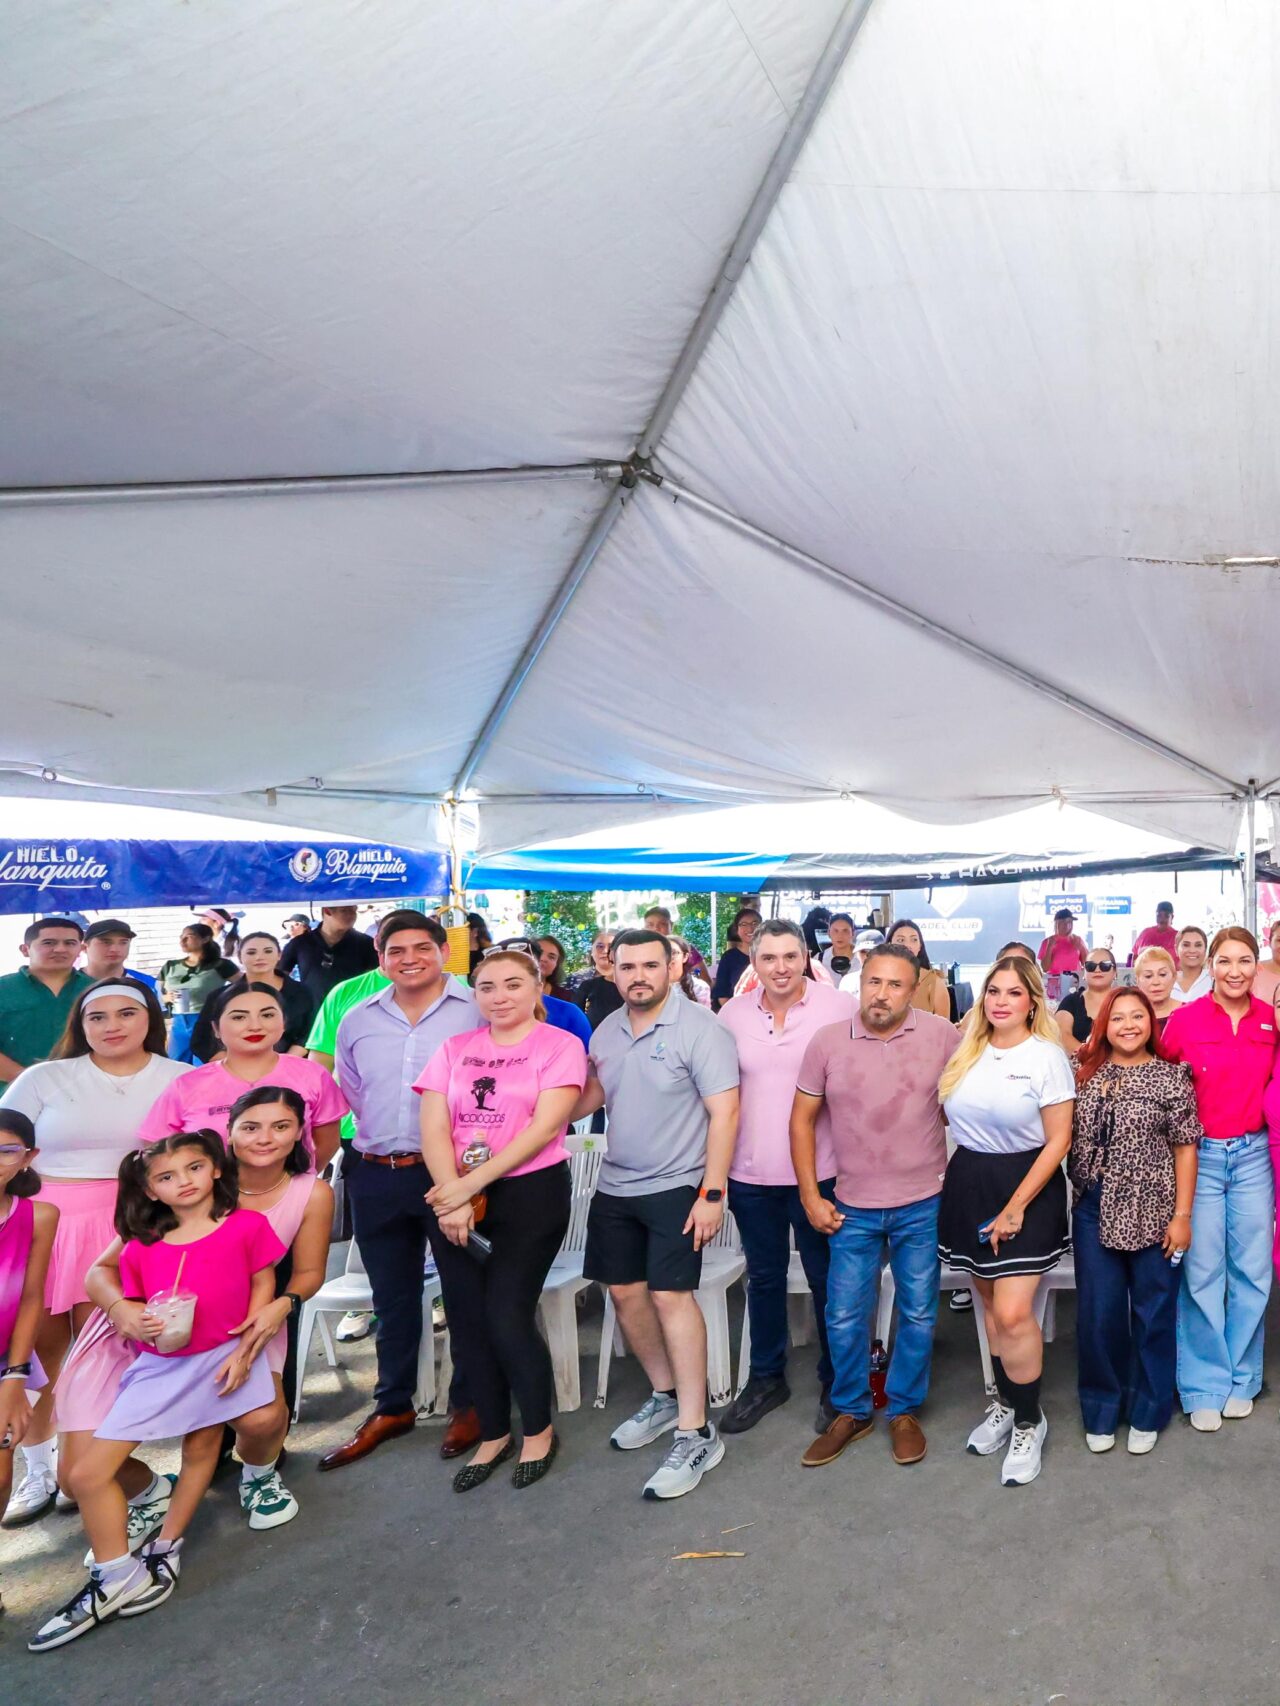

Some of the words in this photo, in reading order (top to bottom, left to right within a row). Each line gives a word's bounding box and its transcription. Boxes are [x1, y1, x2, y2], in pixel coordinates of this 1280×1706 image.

[17, 845, 78, 863] HIELO
[358, 849, 392, 862] HIELO
[325, 848, 407, 883] Blanquita
[689, 1448, 708, 1471] HOKA
